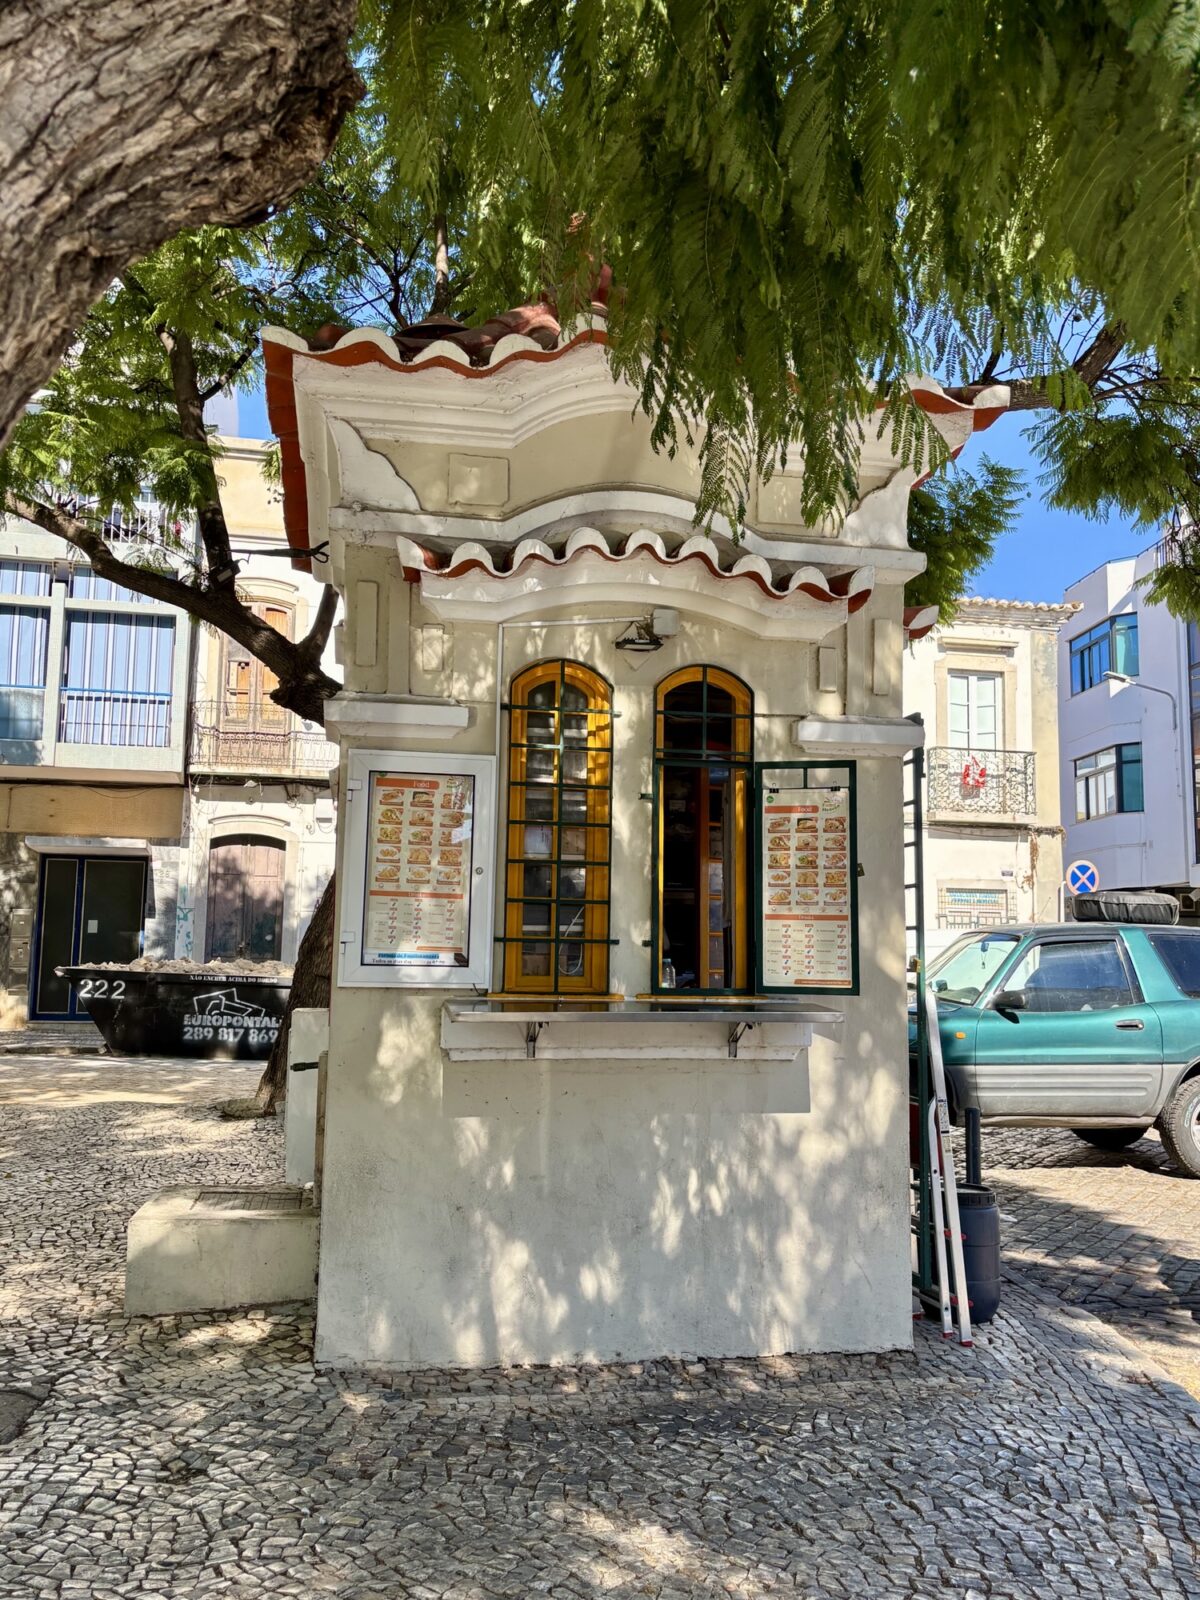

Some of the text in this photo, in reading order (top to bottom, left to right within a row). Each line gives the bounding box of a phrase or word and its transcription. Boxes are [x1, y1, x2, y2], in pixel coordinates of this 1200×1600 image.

[79, 979, 126, 999] 222
[183, 1027, 278, 1043] 289 817 869
